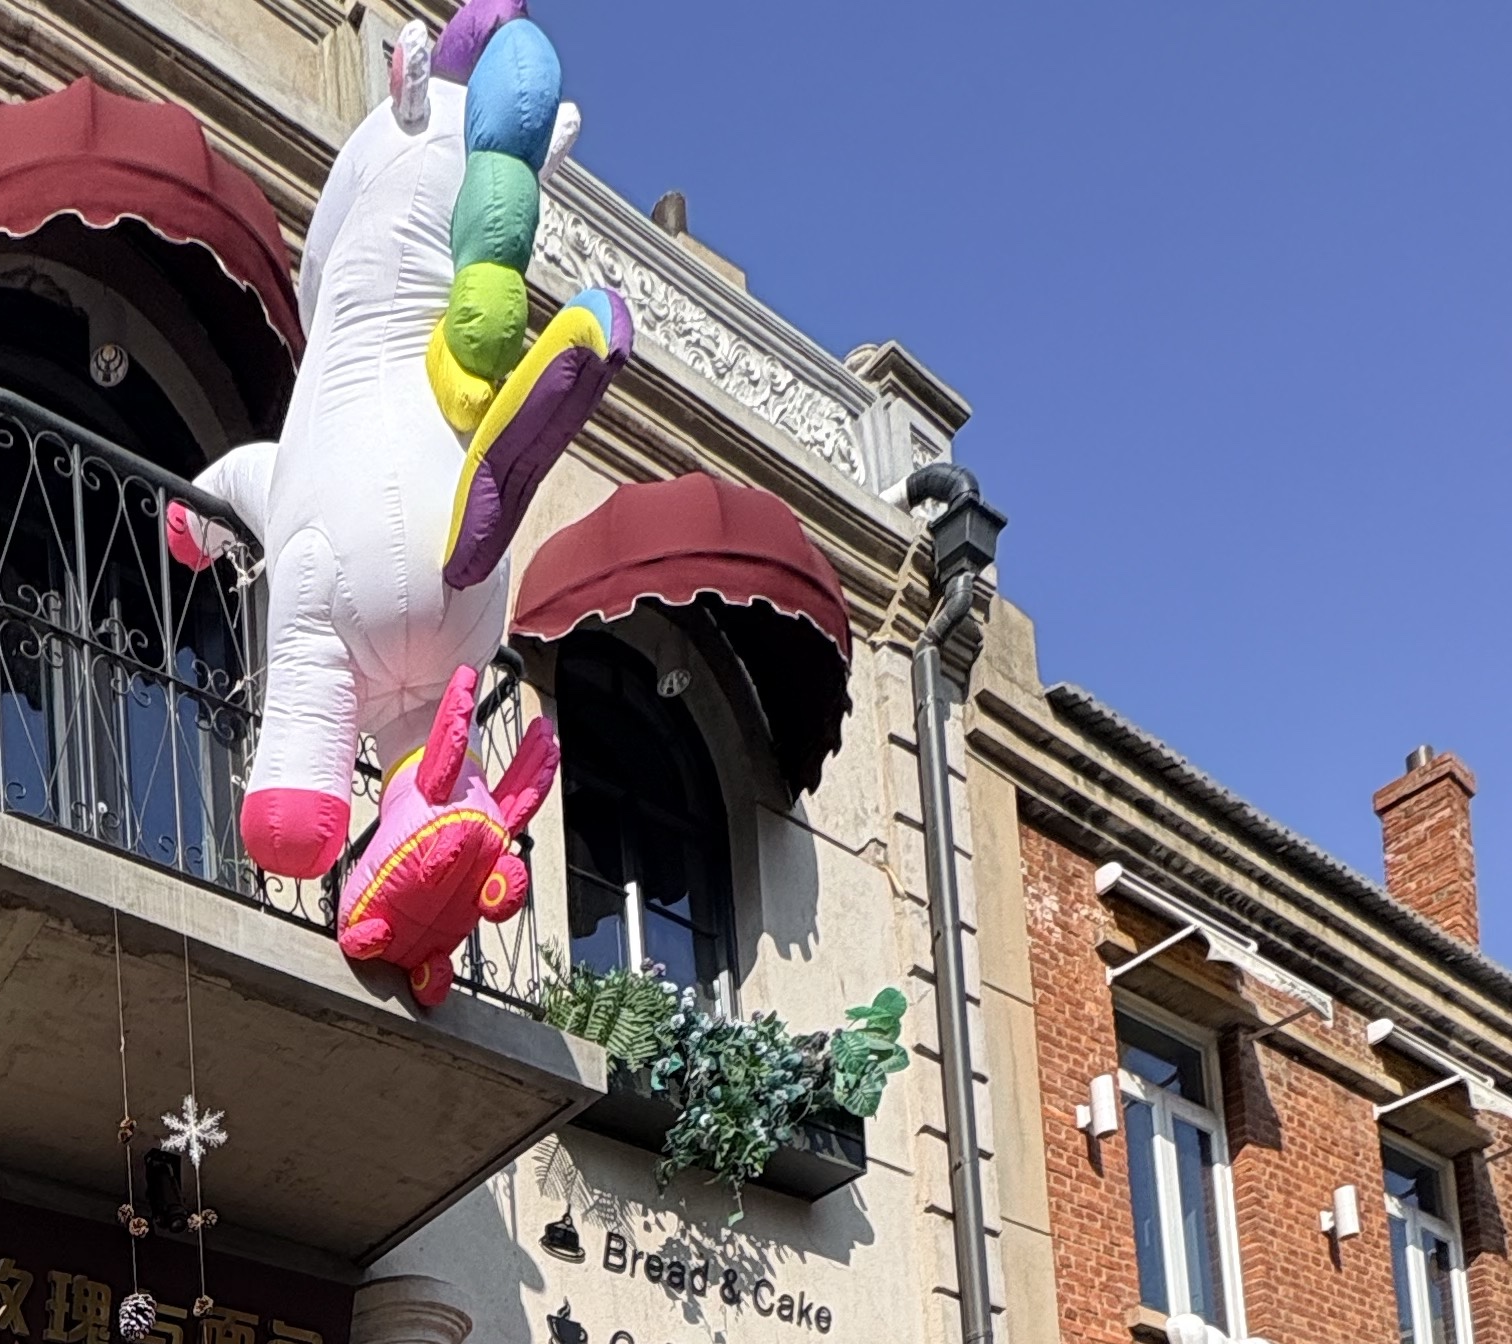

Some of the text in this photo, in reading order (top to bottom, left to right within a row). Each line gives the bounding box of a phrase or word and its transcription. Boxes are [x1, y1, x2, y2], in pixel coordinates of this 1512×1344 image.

[603, 1233, 832, 1334] Bread & Cake
